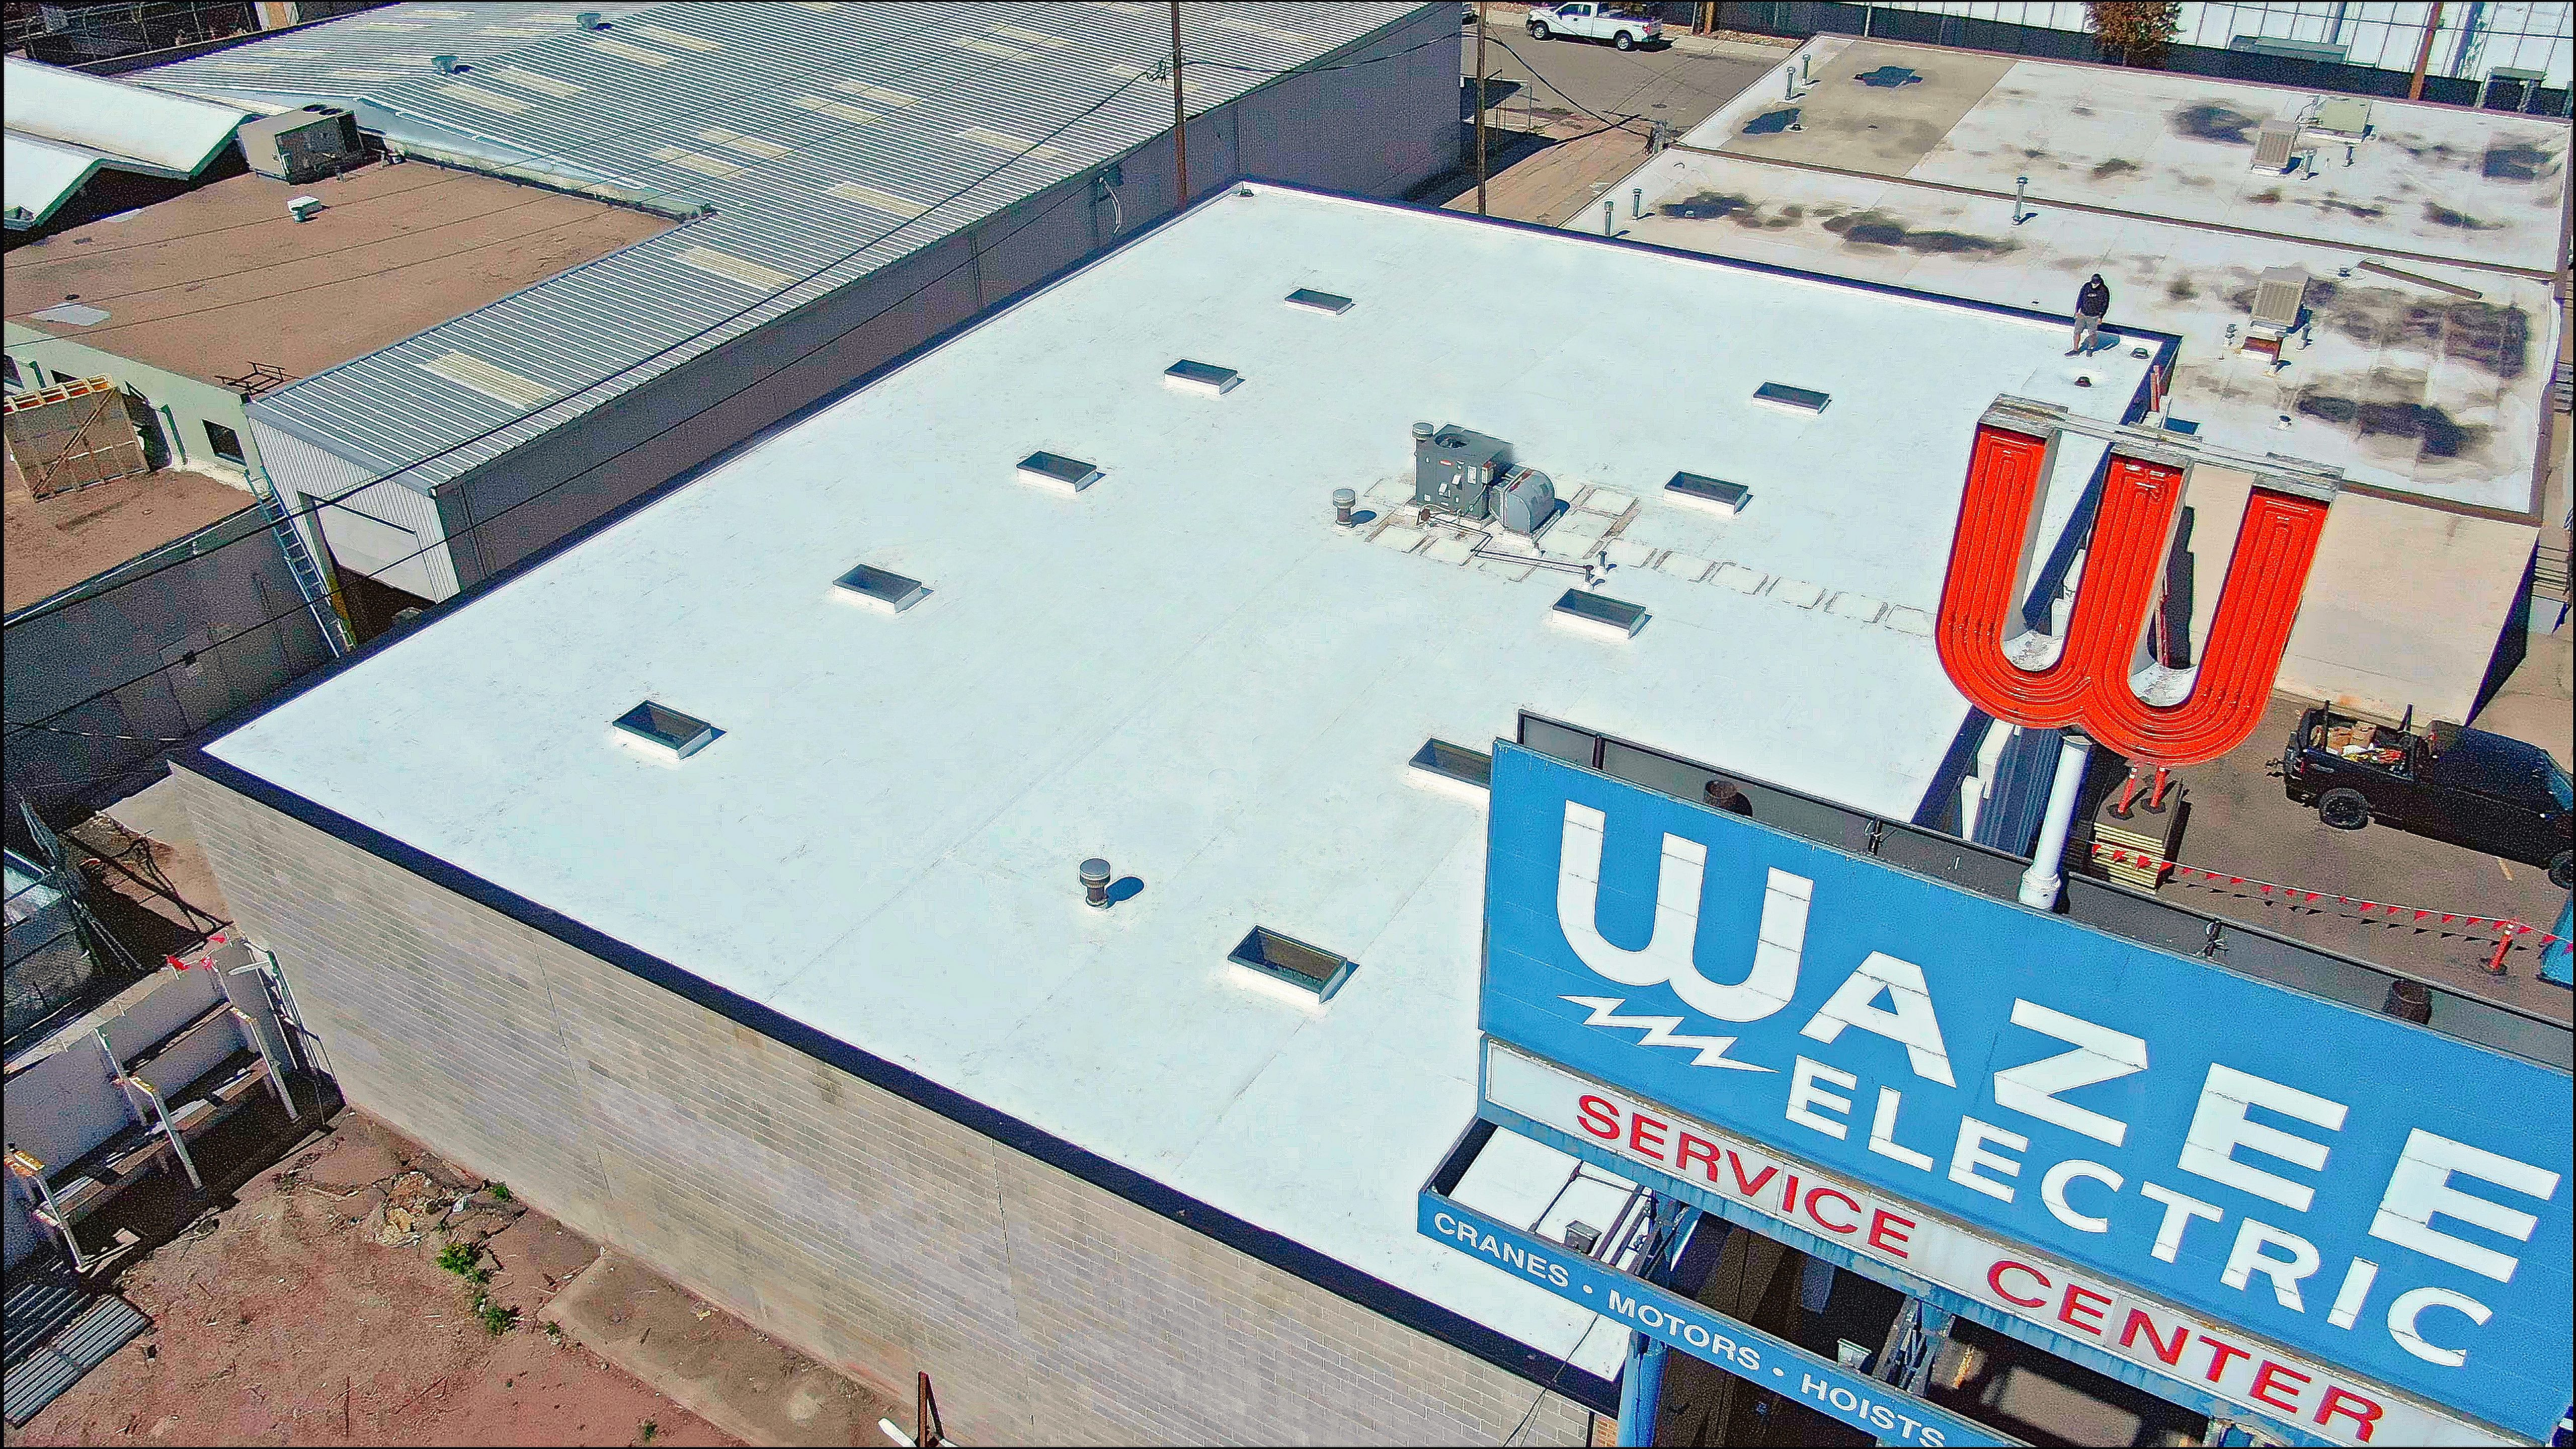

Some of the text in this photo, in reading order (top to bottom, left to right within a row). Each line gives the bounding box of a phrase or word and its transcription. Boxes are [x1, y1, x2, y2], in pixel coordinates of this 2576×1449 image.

[1935, 422, 2332, 765] W
[1557, 799, 2561, 1283] WAZEE
[1786, 1055, 2493, 1367] ELECTRIC
[1435, 1213, 1946, 1447] CRANES MOTORS HOISTS
[1576, 1093, 2385, 1443] SERVICE CENTER
